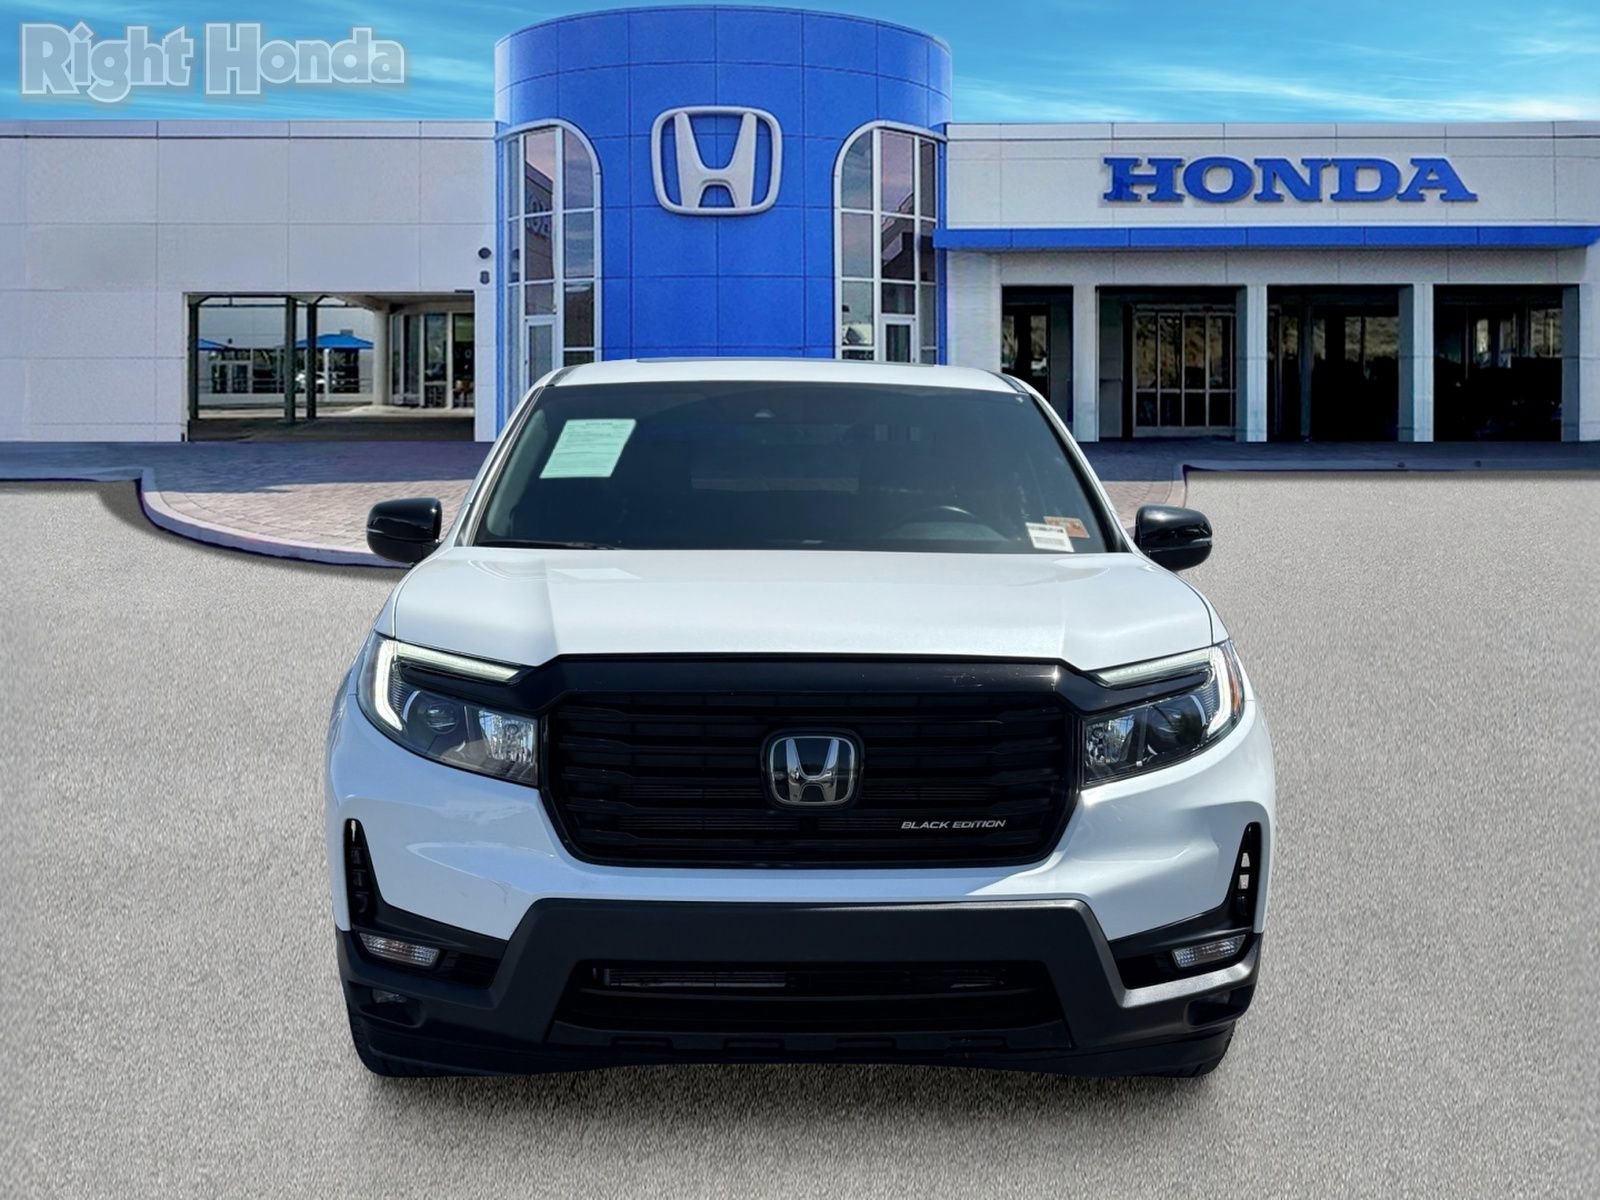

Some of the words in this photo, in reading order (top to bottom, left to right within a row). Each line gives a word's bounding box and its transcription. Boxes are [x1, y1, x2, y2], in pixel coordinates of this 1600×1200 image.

[1103, 155, 1478, 203] HONDA
[900, 820, 950, 830] BLACK
[951, 819, 1007, 829] EDITION
